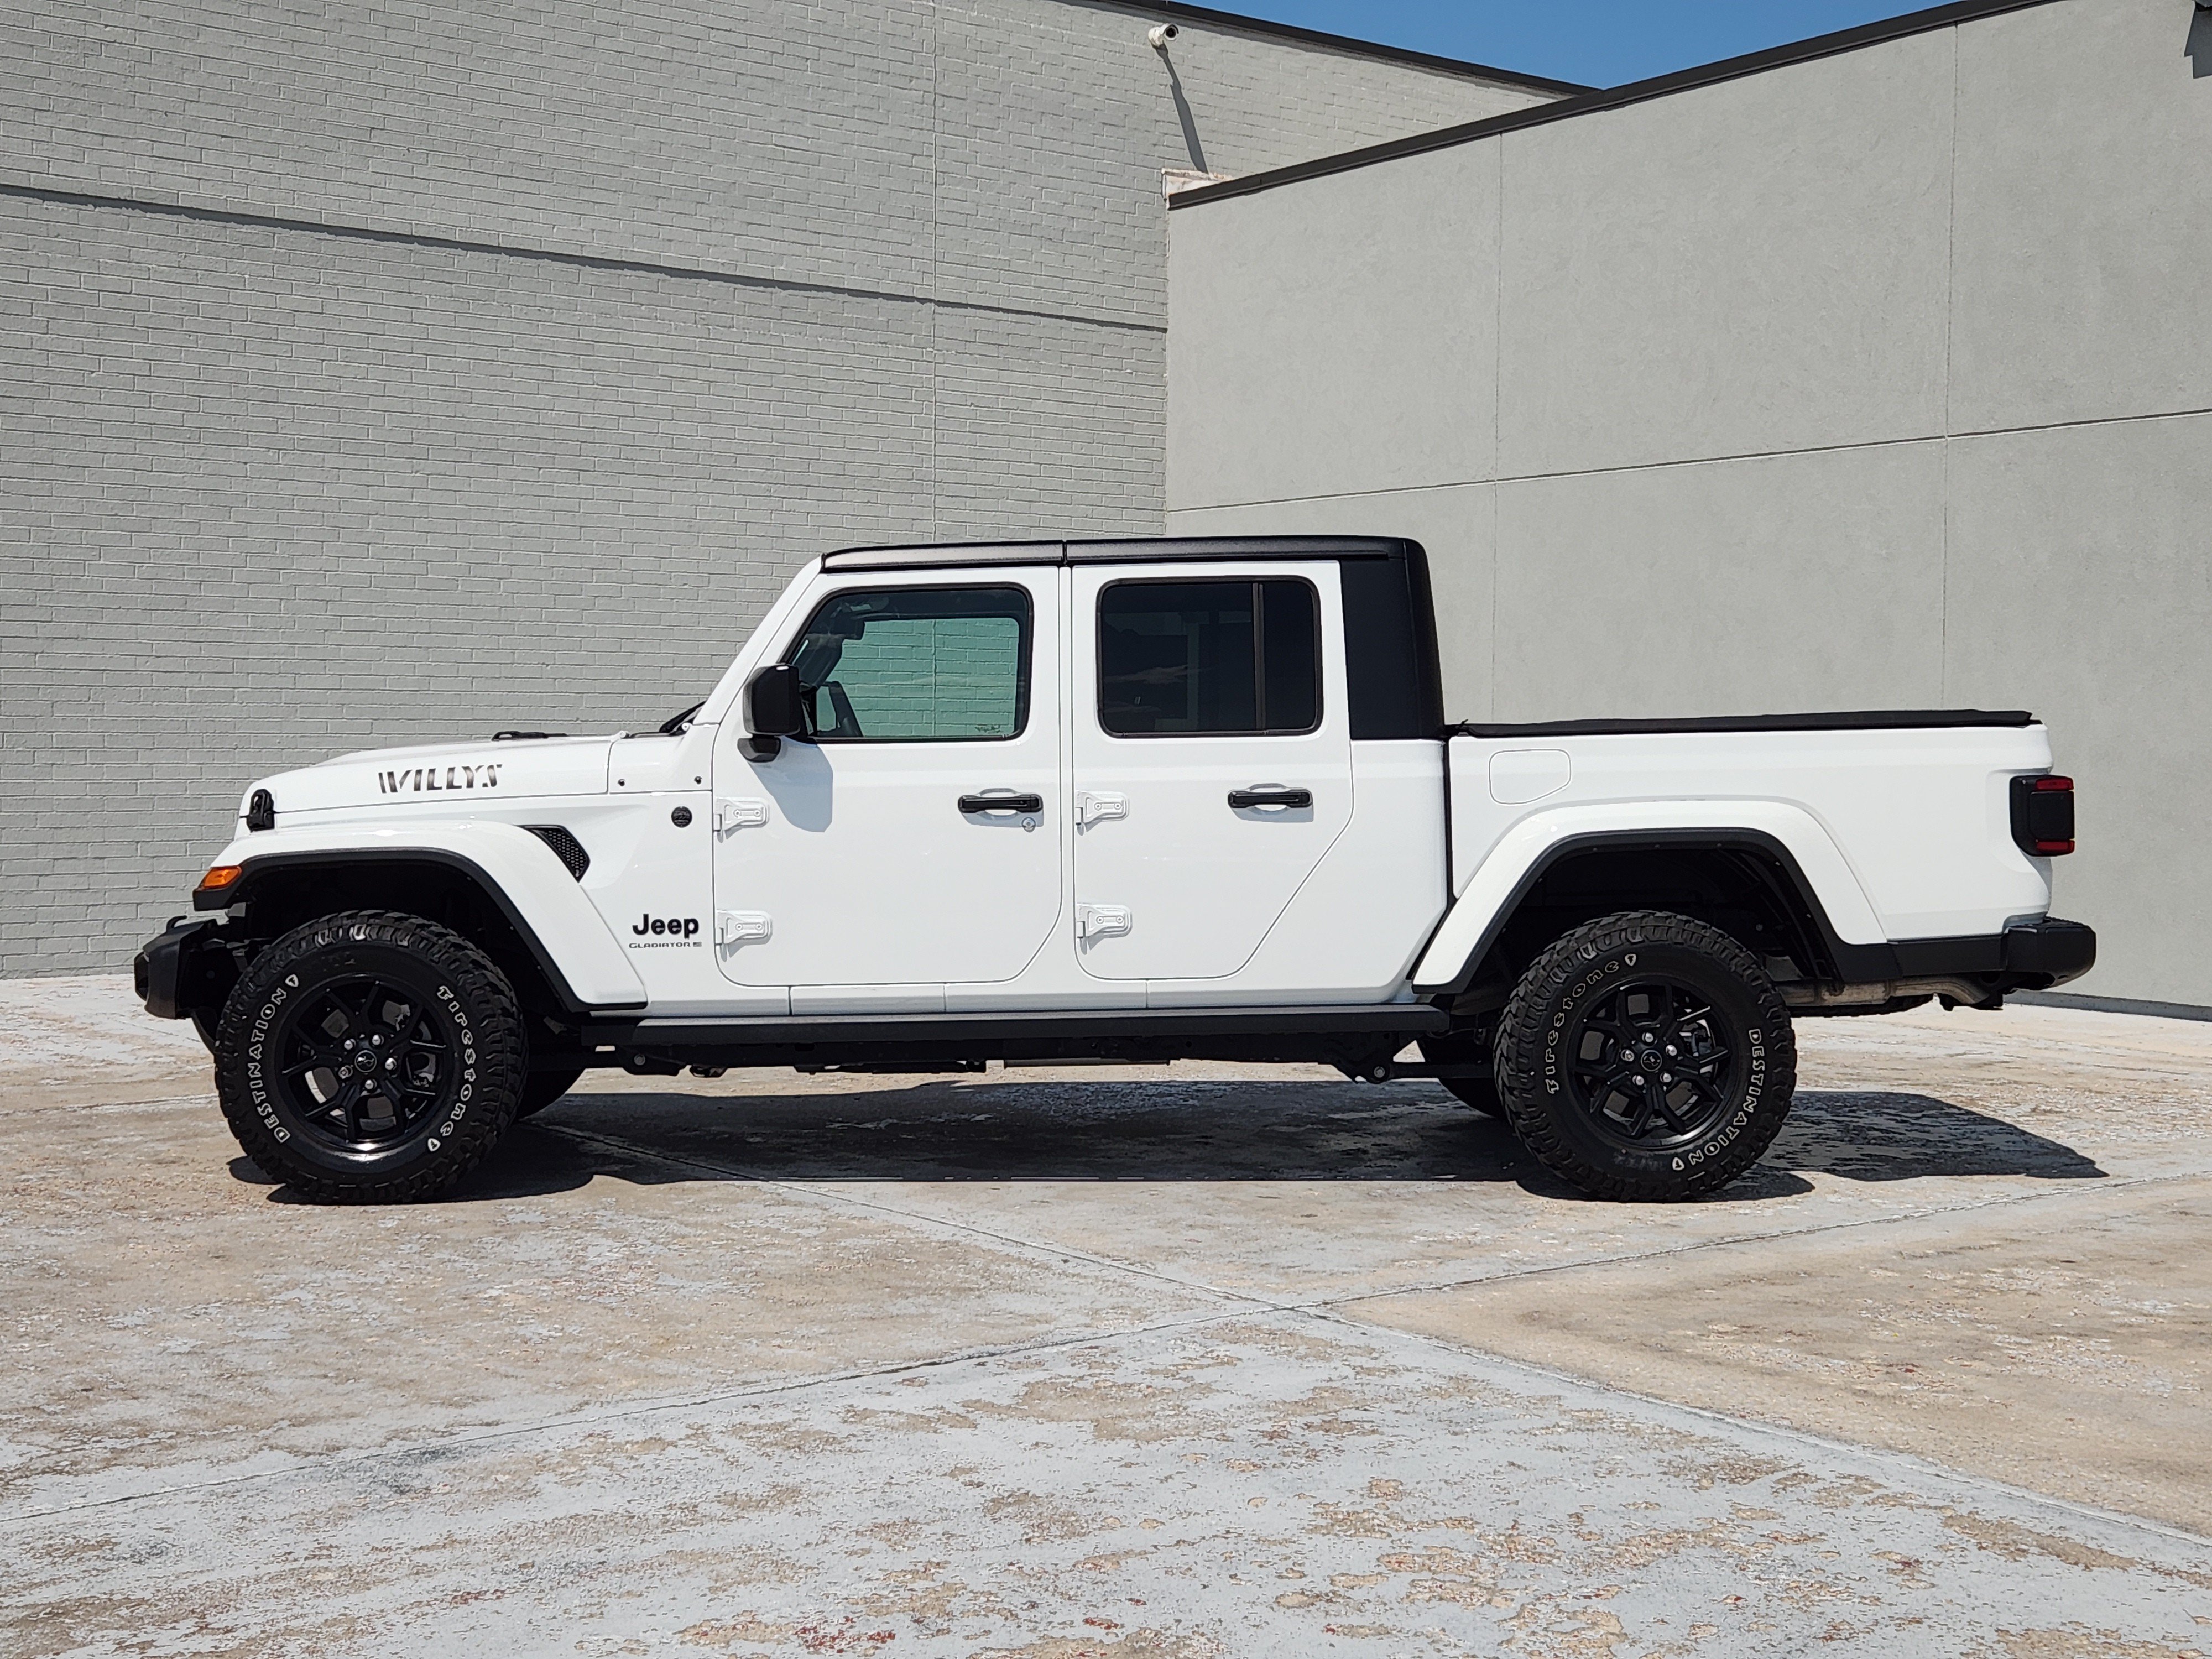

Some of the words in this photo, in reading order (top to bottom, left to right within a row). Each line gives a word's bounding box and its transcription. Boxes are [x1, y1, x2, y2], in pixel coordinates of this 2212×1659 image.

[378, 764, 503, 794] WILLYS
[632, 913, 699, 939] Jeep
[248, 987, 291, 1144] DESTINATION
[1688, 1028, 1765, 1165] DESTINATION
